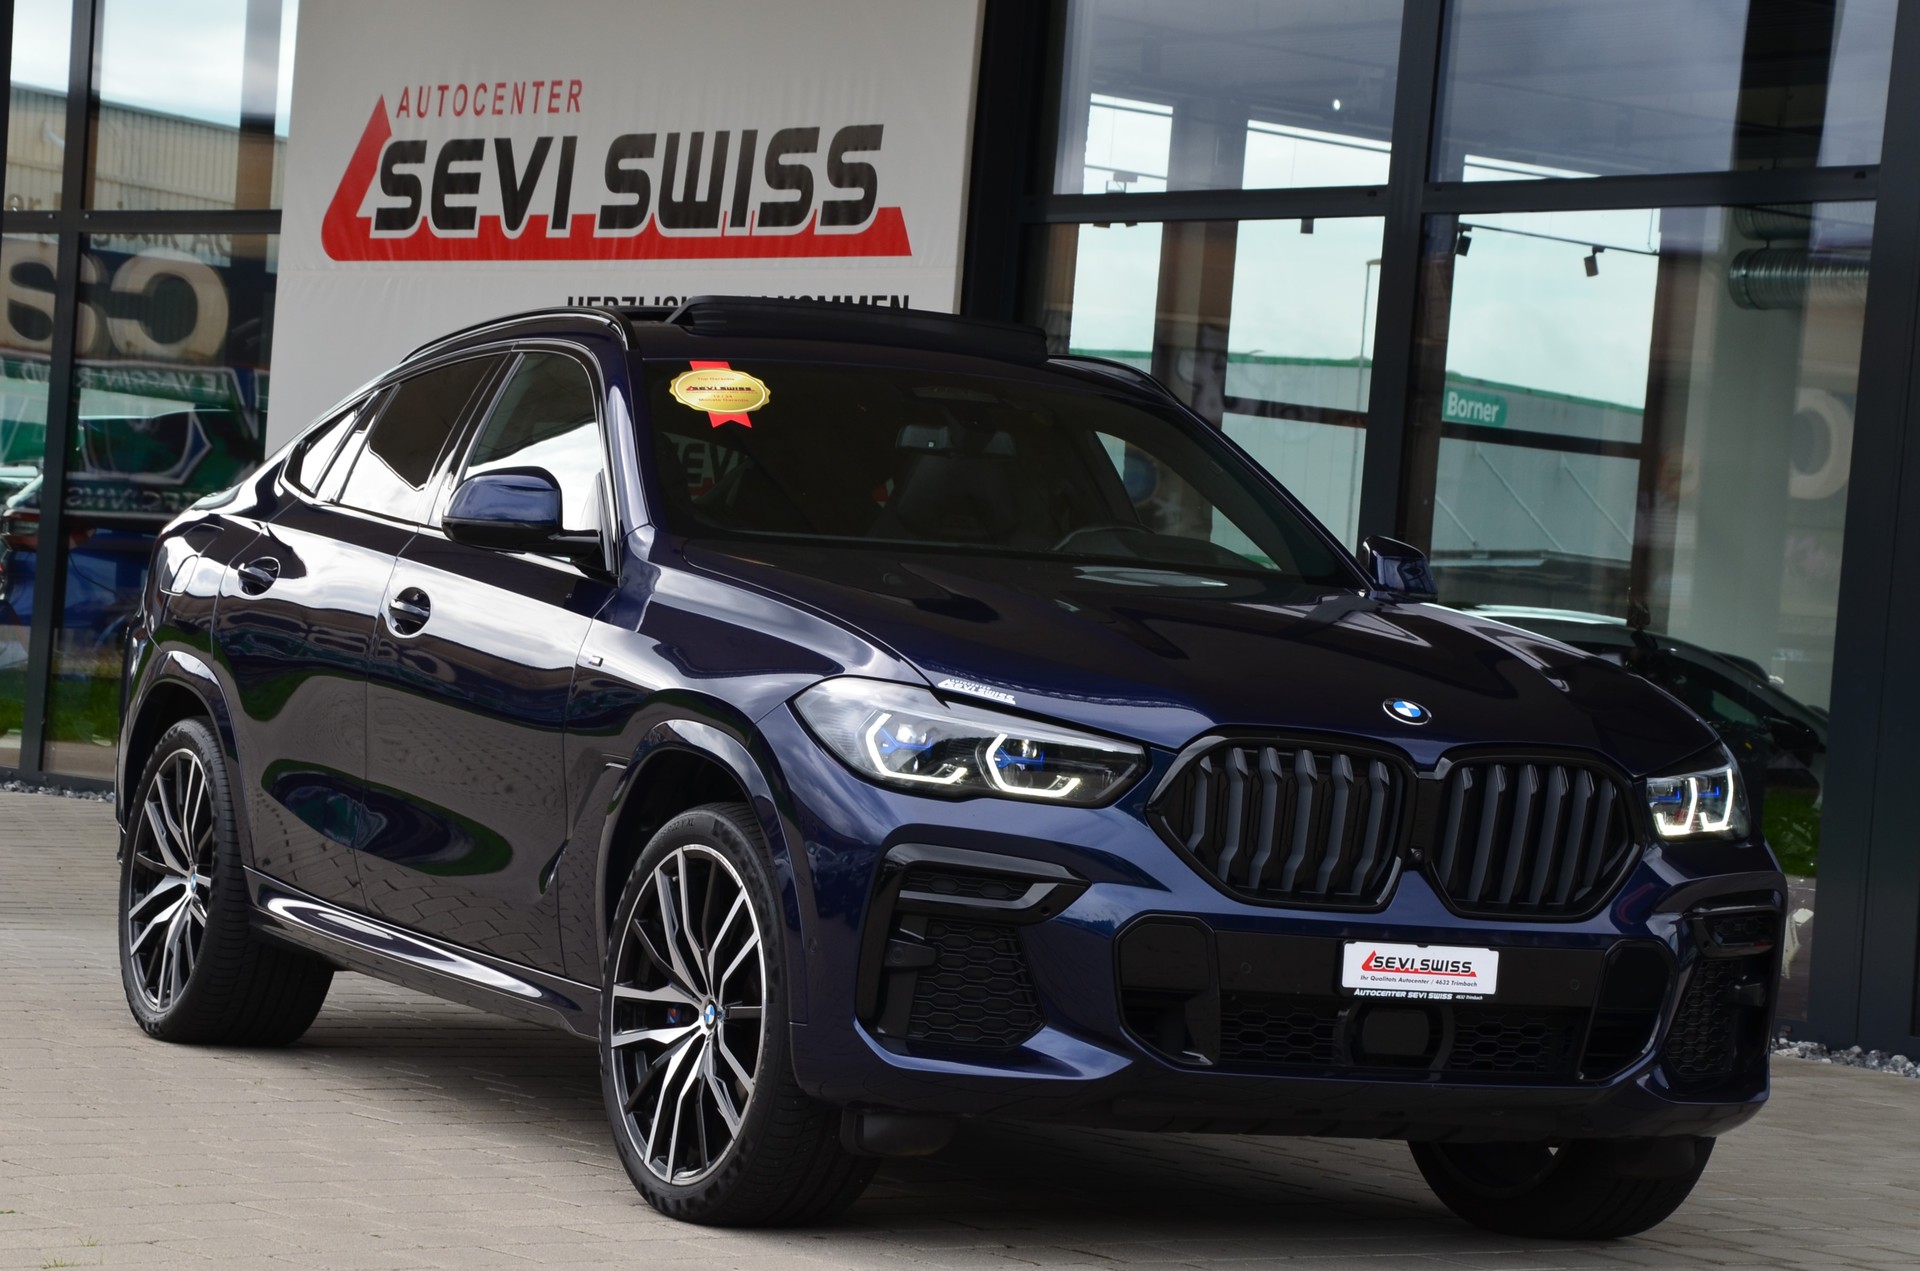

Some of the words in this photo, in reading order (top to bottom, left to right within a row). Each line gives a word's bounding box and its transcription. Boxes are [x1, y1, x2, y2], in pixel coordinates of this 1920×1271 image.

[396, 79, 583, 119] AUTOCENTER
[374, 136, 578, 232] SEVI
[598, 124, 884, 230] SWISS
[1446, 391, 1500, 423] Borner
[1372, 955, 1416, 971] SEVI
[1419, 958, 1472, 974] SWISS
[1398, 977, 1430, 985] Autocenter
[1353, 988, 1407, 999] AUTOCENTER
[1407, 991, 1428, 999] SEVI
[1428, 992, 1453, 1001] SWISS
